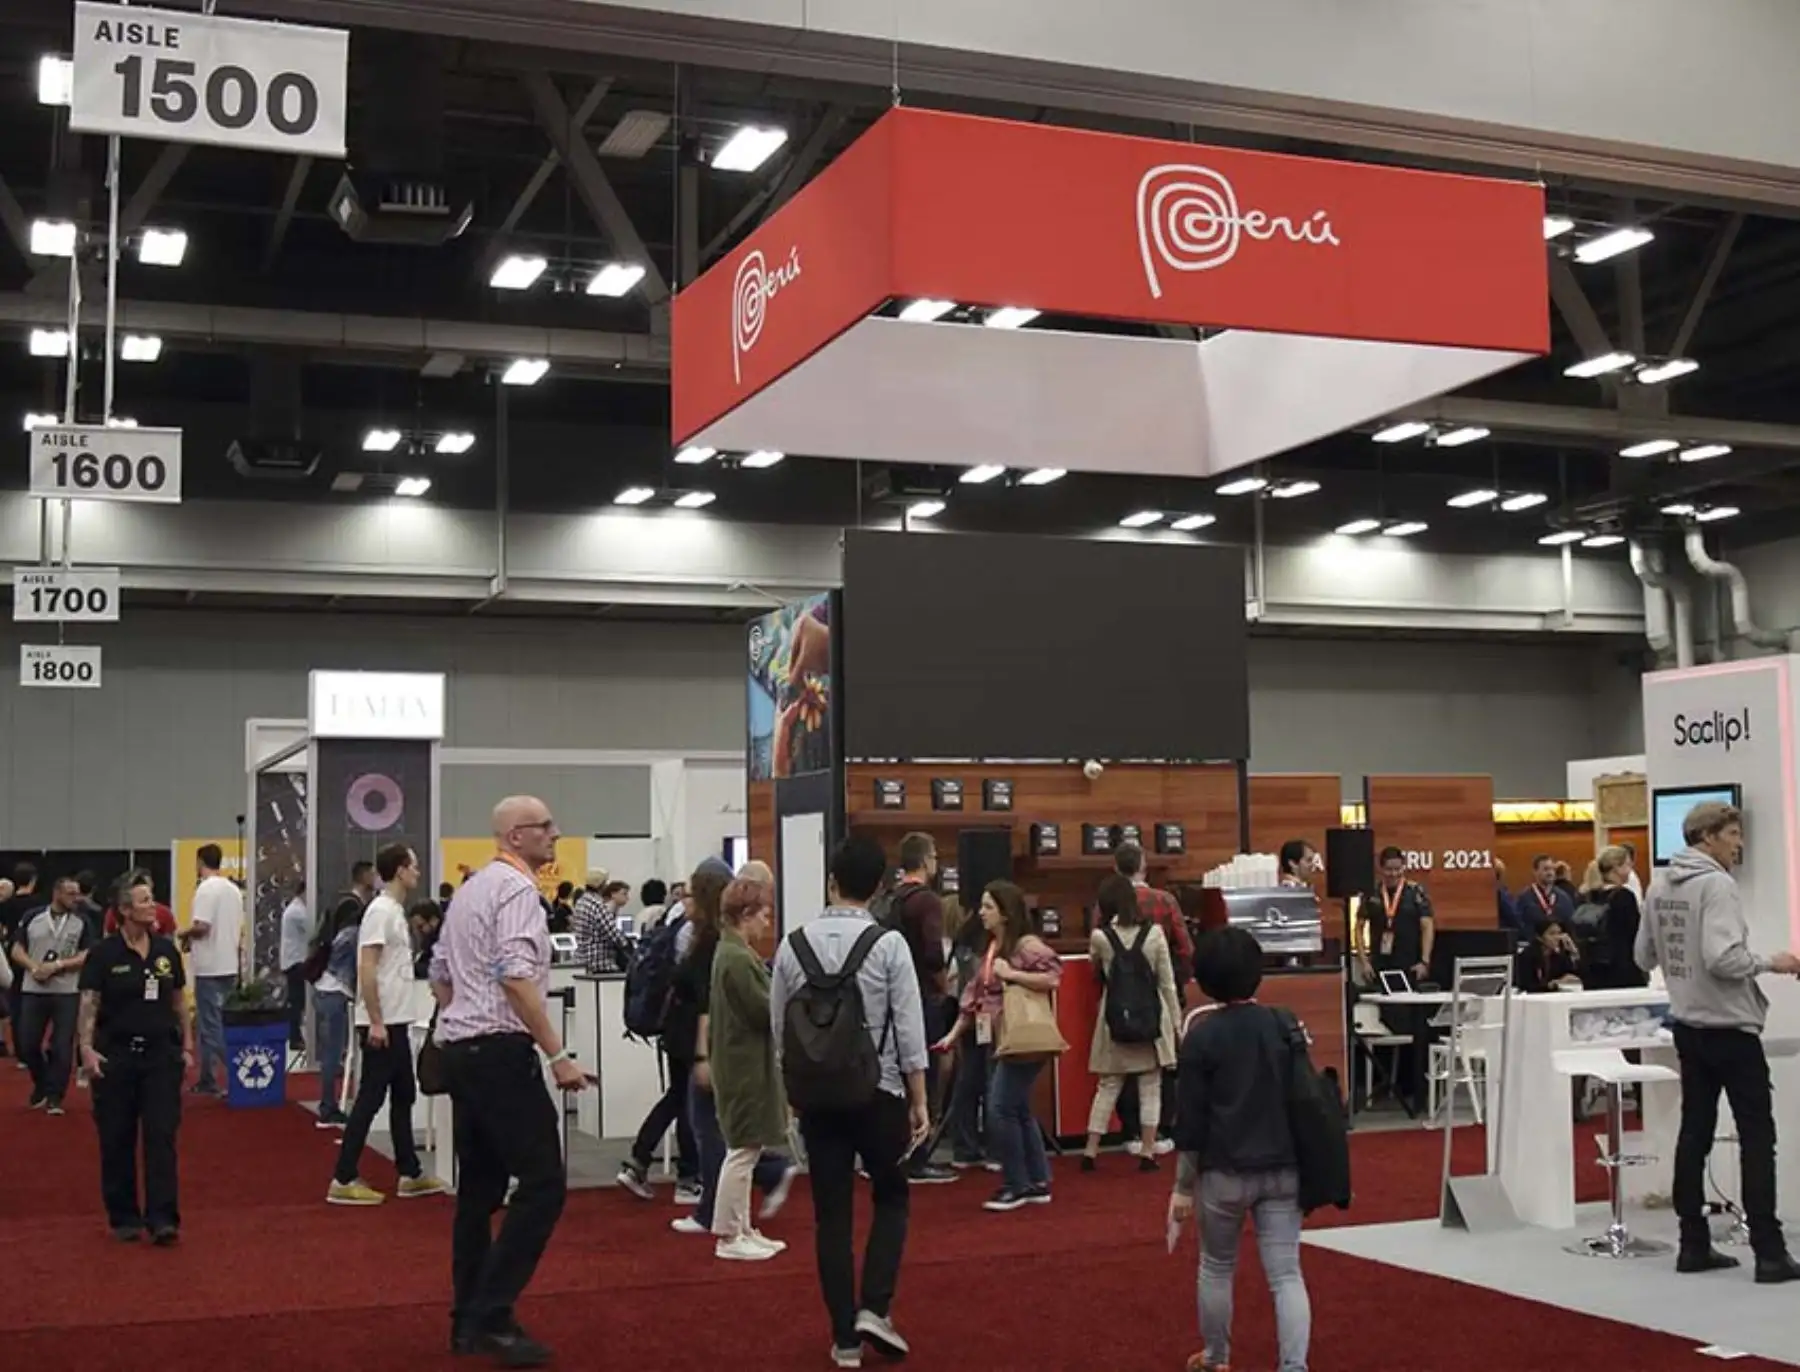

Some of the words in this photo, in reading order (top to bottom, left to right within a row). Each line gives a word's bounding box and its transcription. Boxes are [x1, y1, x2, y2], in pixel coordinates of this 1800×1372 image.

[94, 20, 181, 49] AISLE
[114, 55, 319, 136] 1500
[1136, 163, 1341, 299] Perú
[732, 246, 802, 384] Perú
[41, 433, 90, 448] AISLE
[51, 452, 167, 491] 1600
[30, 587, 109, 614] 1700
[33, 661, 93, 682] 1800
[1443, 850, 1493, 869] 2021
